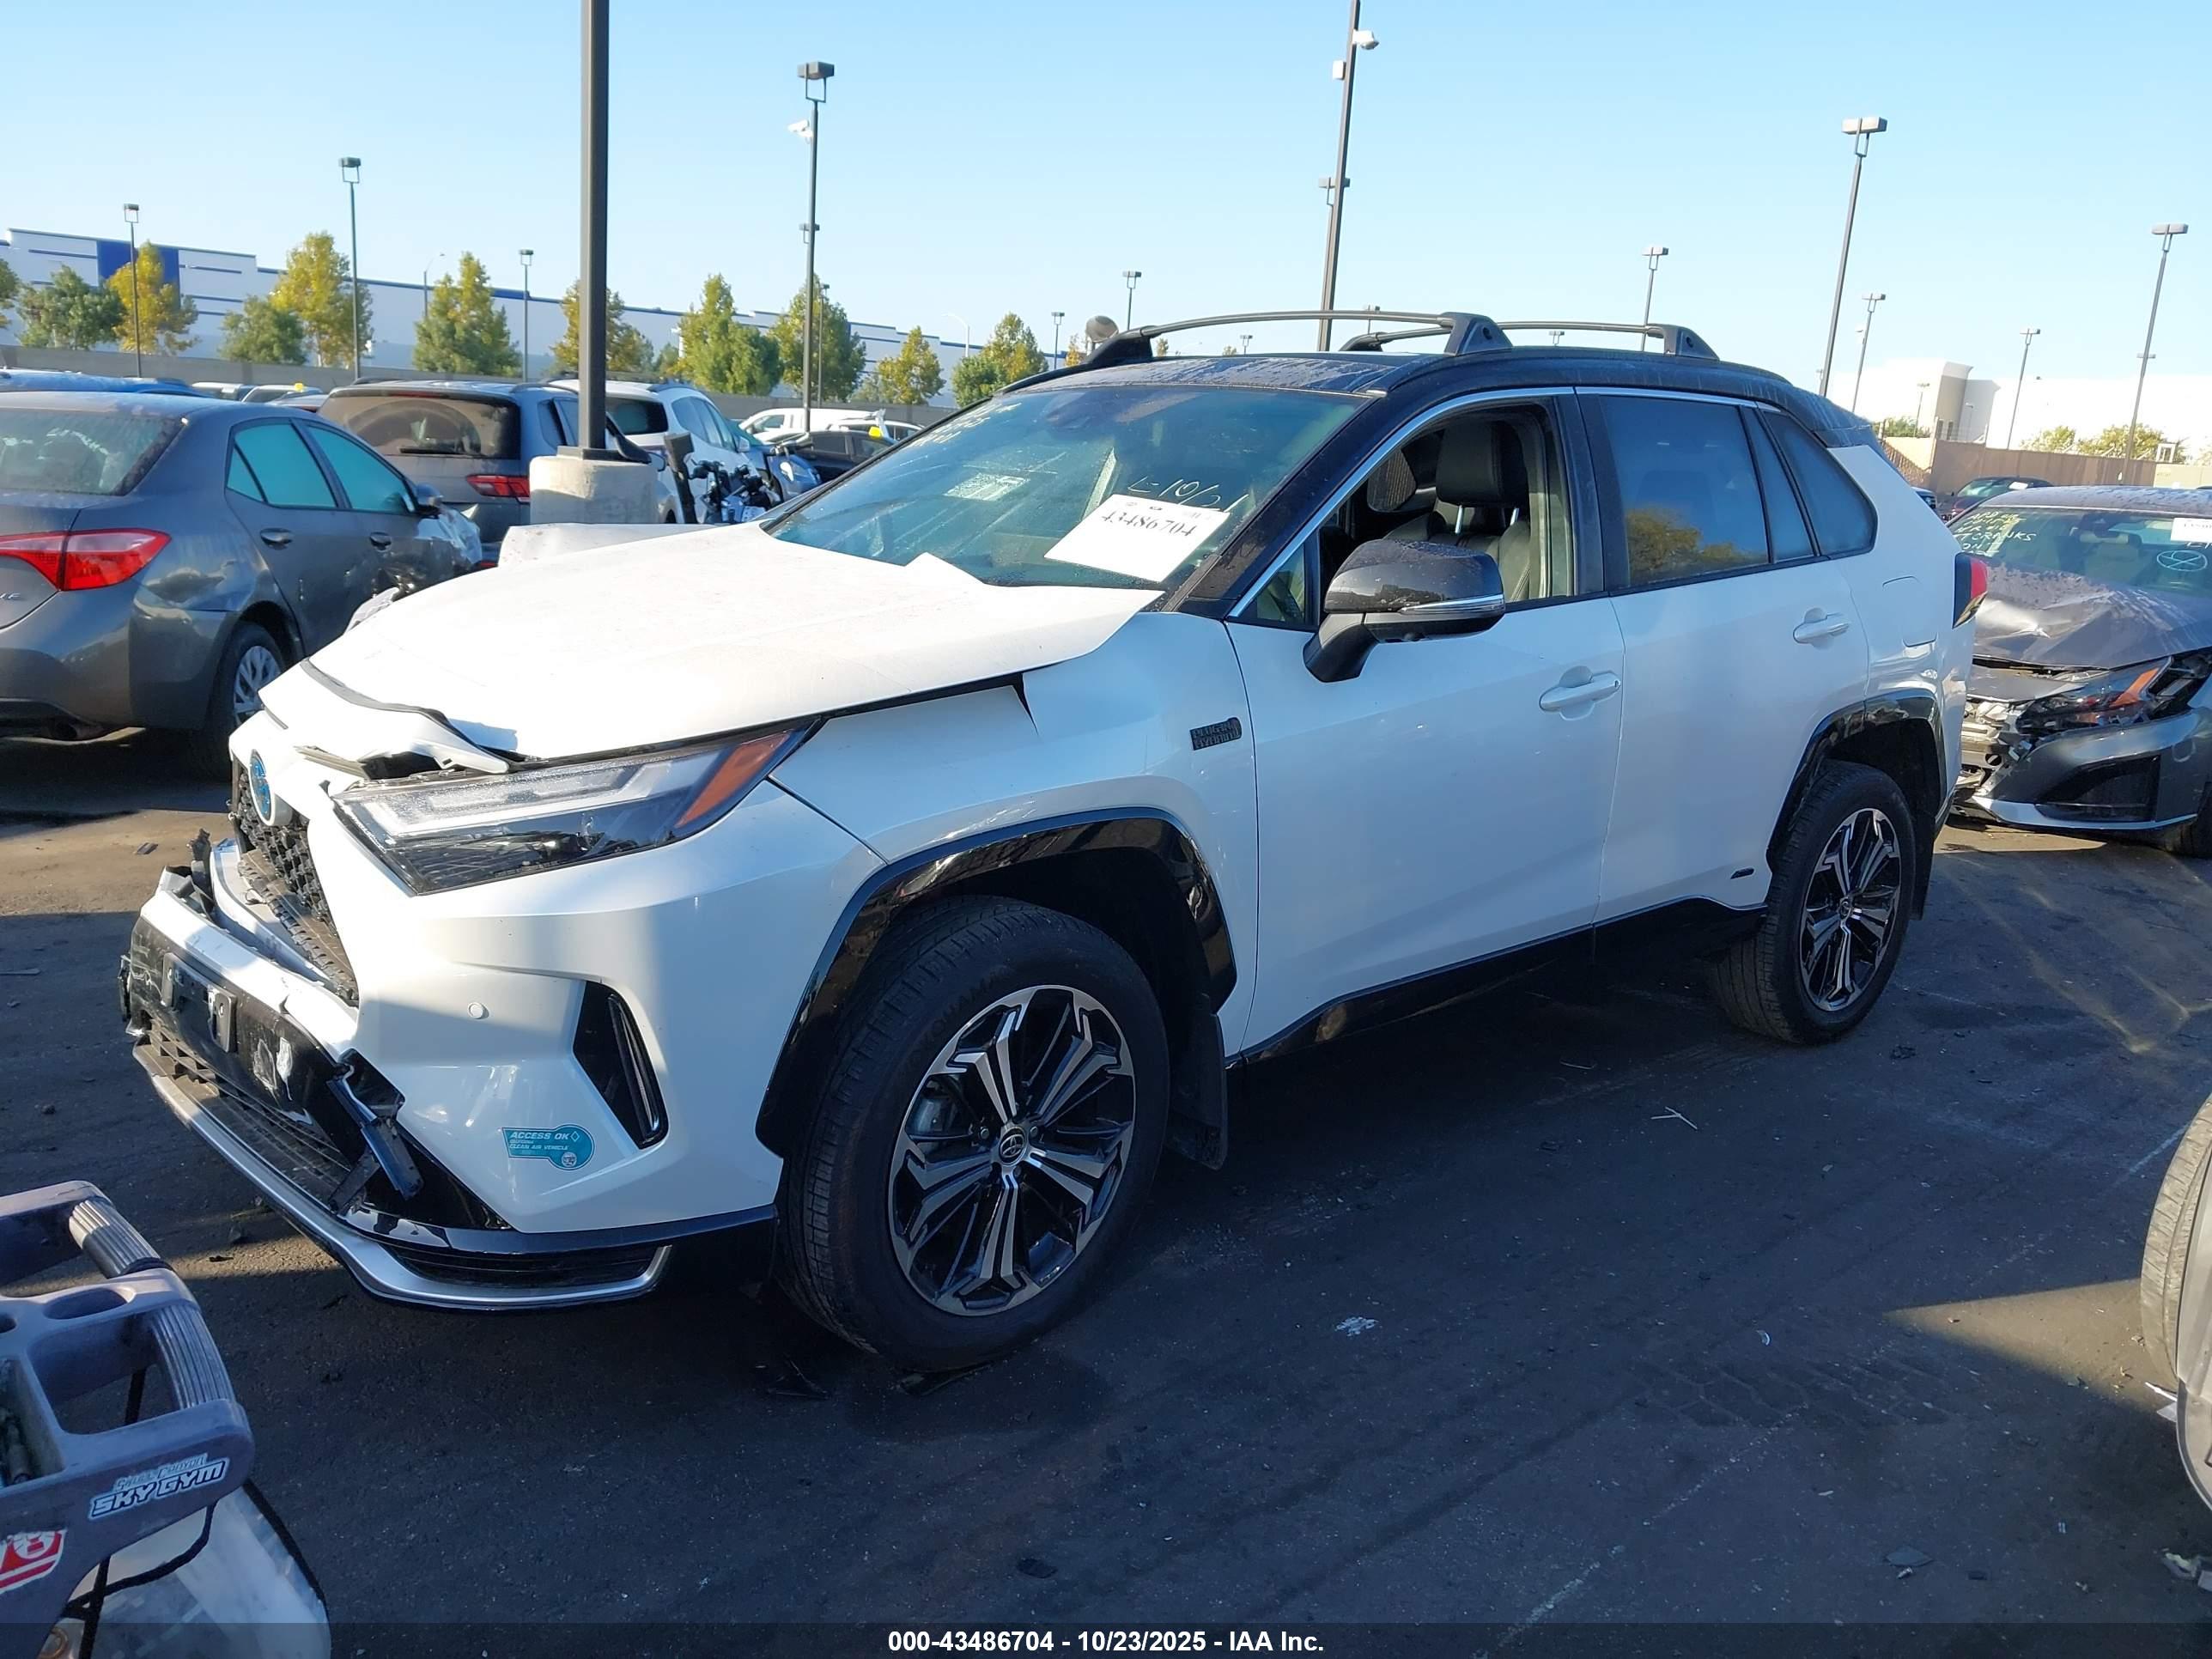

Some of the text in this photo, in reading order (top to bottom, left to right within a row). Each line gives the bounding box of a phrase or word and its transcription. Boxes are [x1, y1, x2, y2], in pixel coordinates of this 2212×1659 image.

[1101, 509, 1198, 537] 43486704
[509, 1131, 552, 1140] ACCESS
[92, 1481, 157, 1517] SKY
[156, 1461, 227, 1498] GYM
